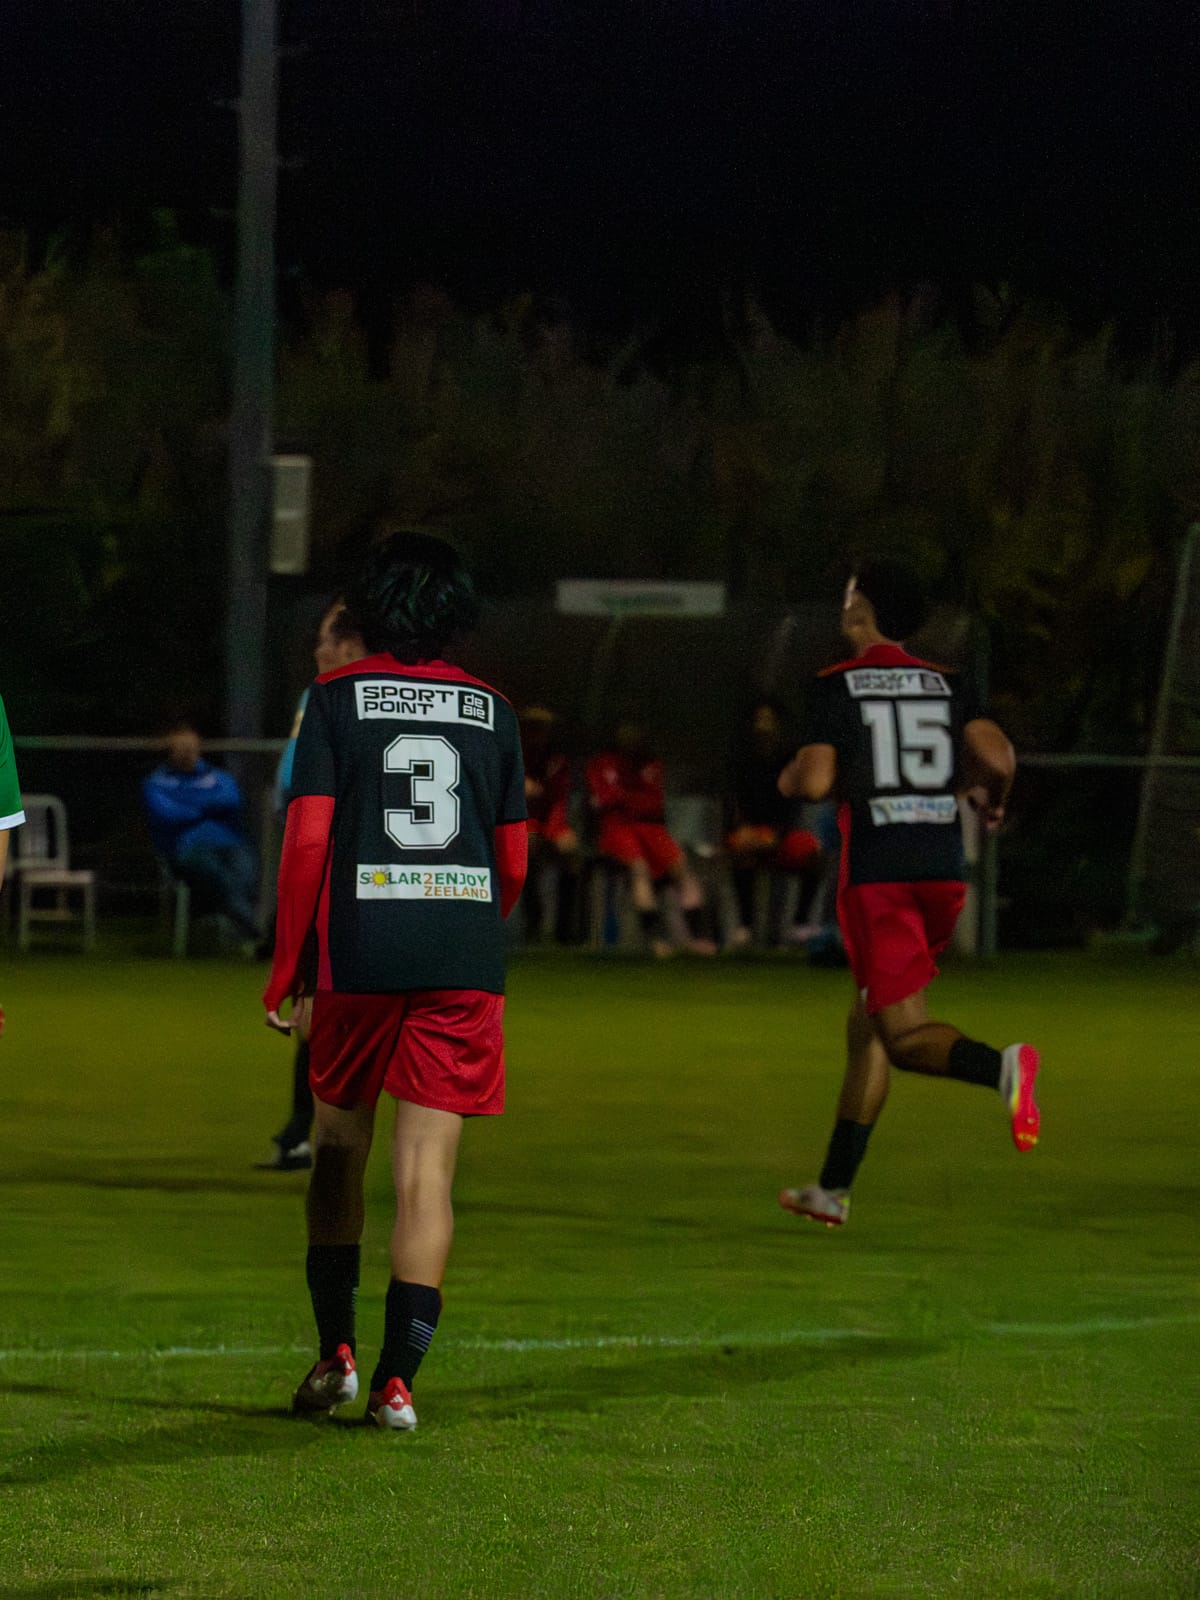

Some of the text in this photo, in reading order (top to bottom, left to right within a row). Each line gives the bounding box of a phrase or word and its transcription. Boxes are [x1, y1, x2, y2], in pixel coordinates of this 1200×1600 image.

[362, 685, 454, 704] SPORT
[464, 694, 483, 709] de
[364, 701, 434, 716] POINT
[860, 700, 952, 789] 15
[384, 734, 460, 849] 3
[424, 885, 489, 900] ZEELAND
